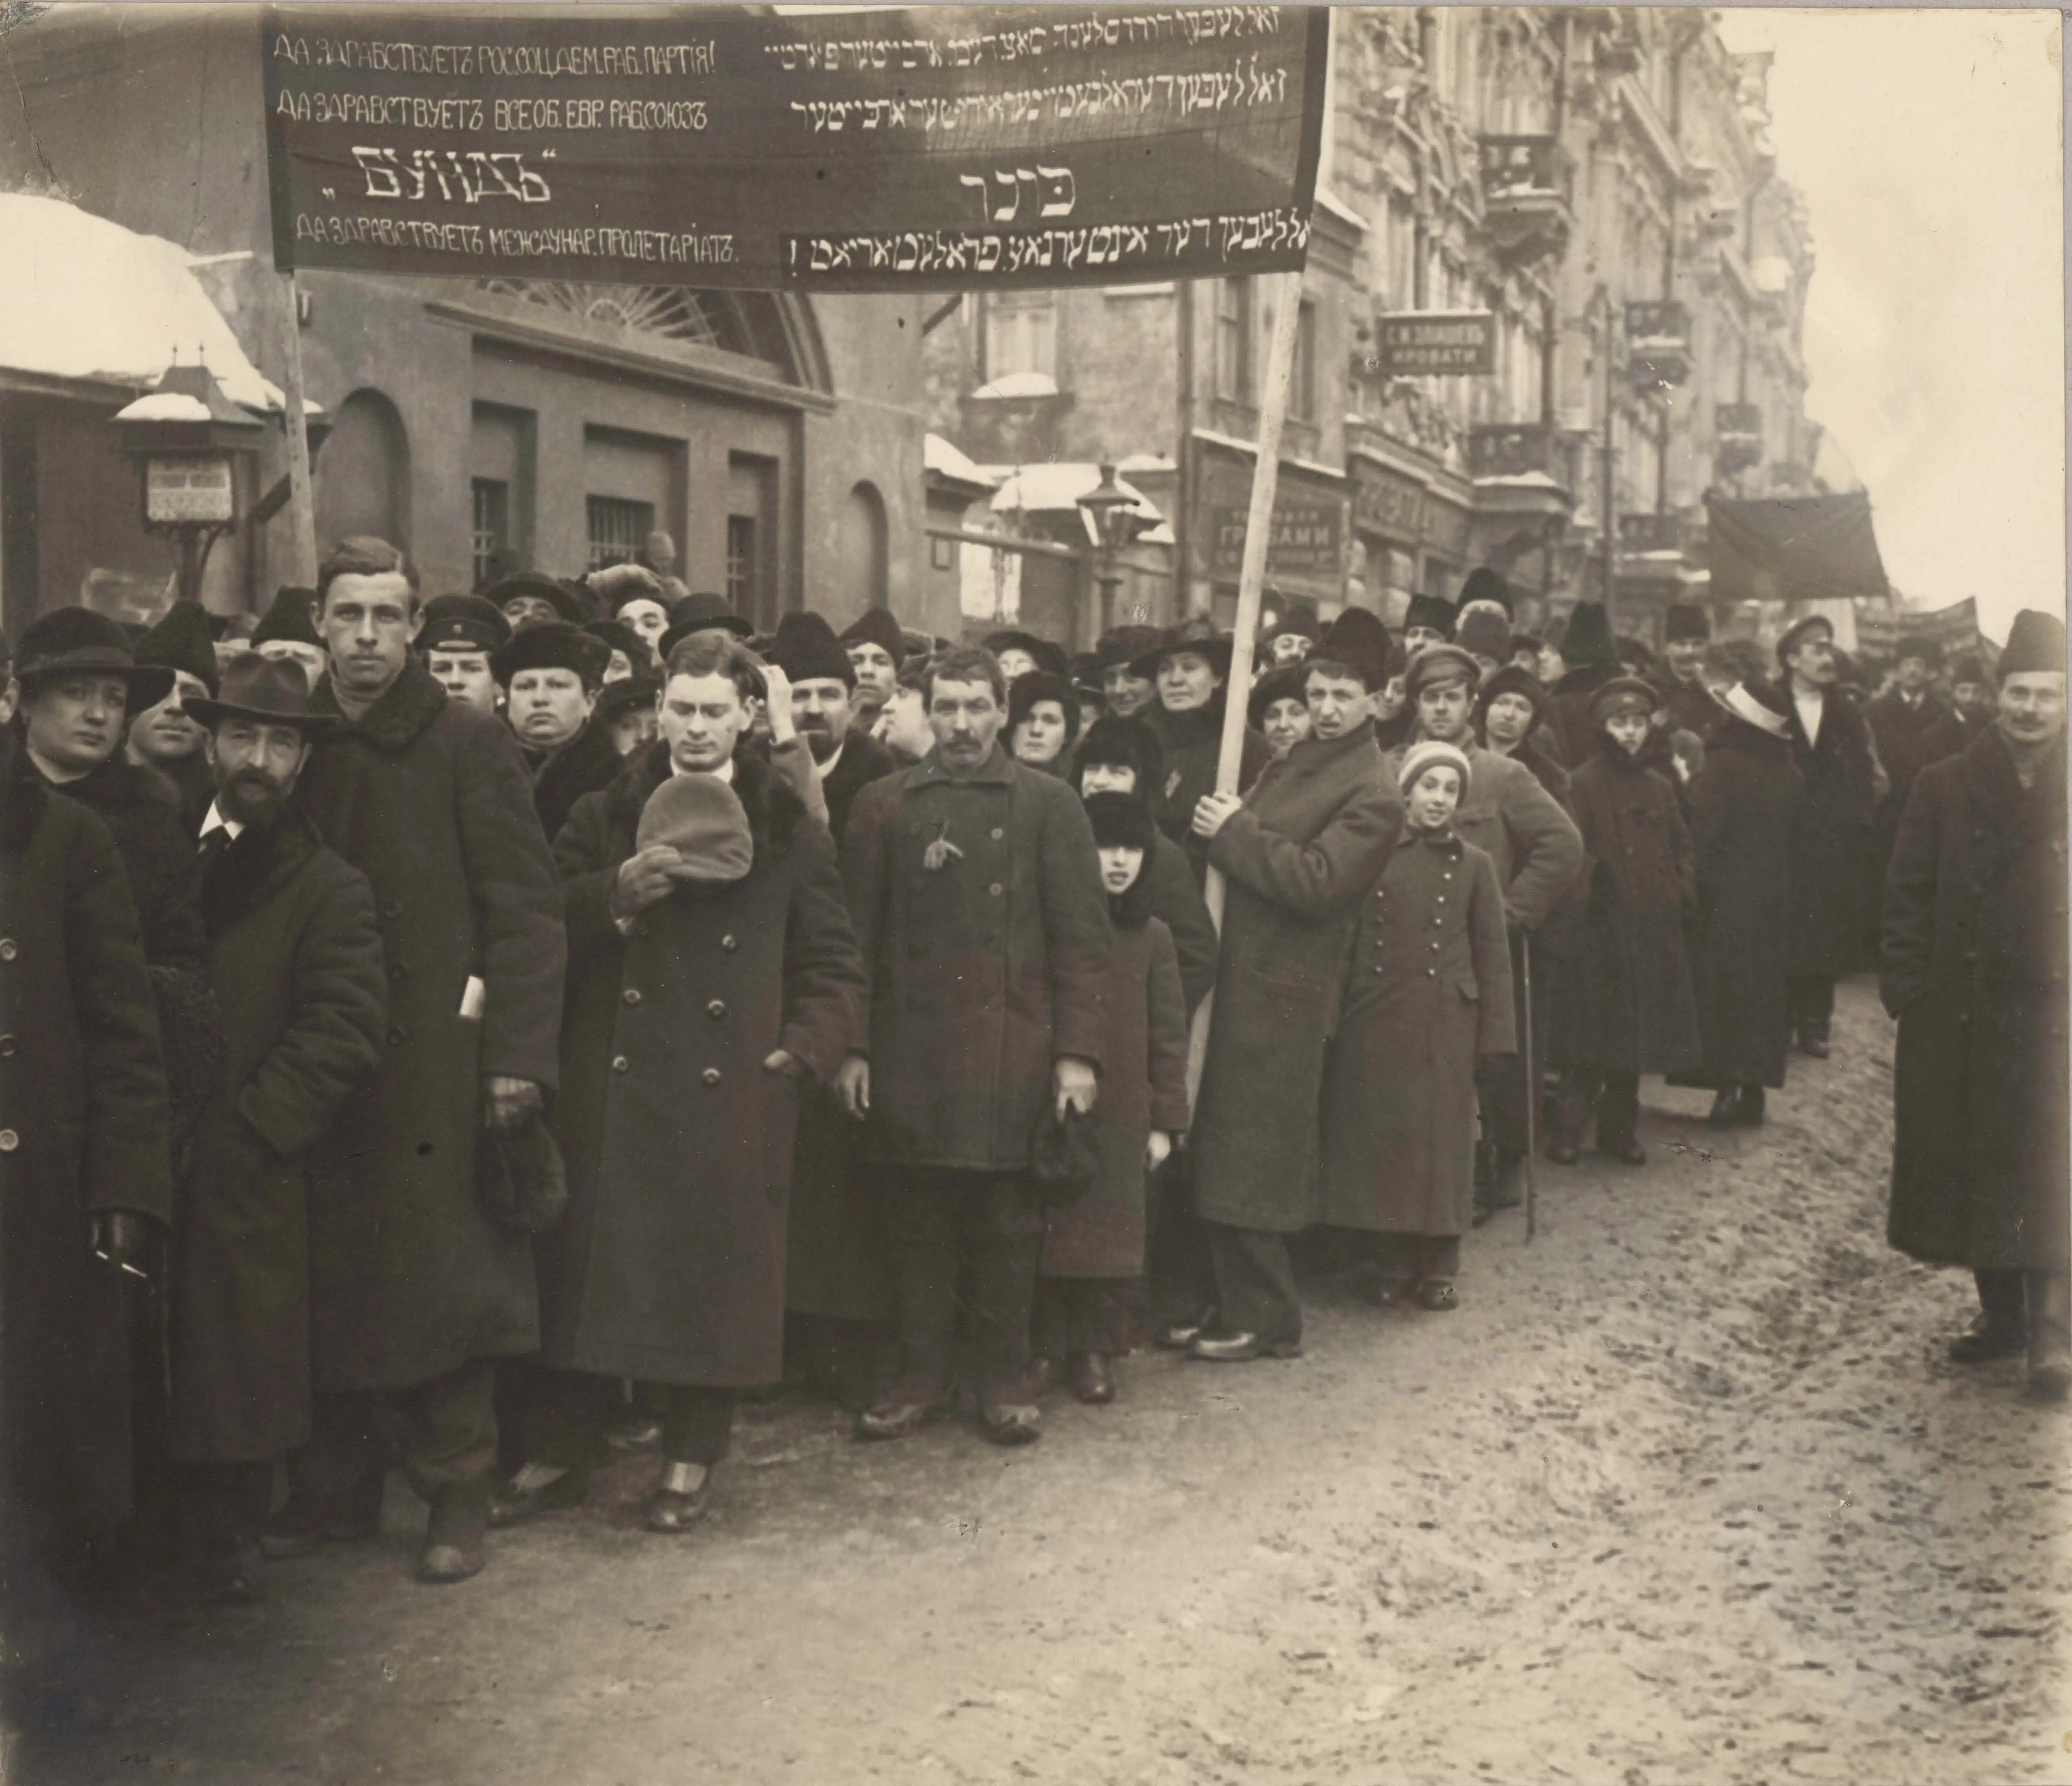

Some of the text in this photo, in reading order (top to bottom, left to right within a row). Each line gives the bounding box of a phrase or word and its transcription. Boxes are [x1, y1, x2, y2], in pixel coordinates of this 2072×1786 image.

[274, 34, 310, 65] ДА
[277, 89, 311, 121] ДА
[314, 92, 483, 130] ЗДРАВСТВУЕТЪ
[494, 99, 562, 131] ВСЕОБ.
[566, 99, 603, 129] ЕВР.
[296, 213, 330, 243] ДА
[329, 216, 483, 255] ЗДРАВСТВУЕТЪ
